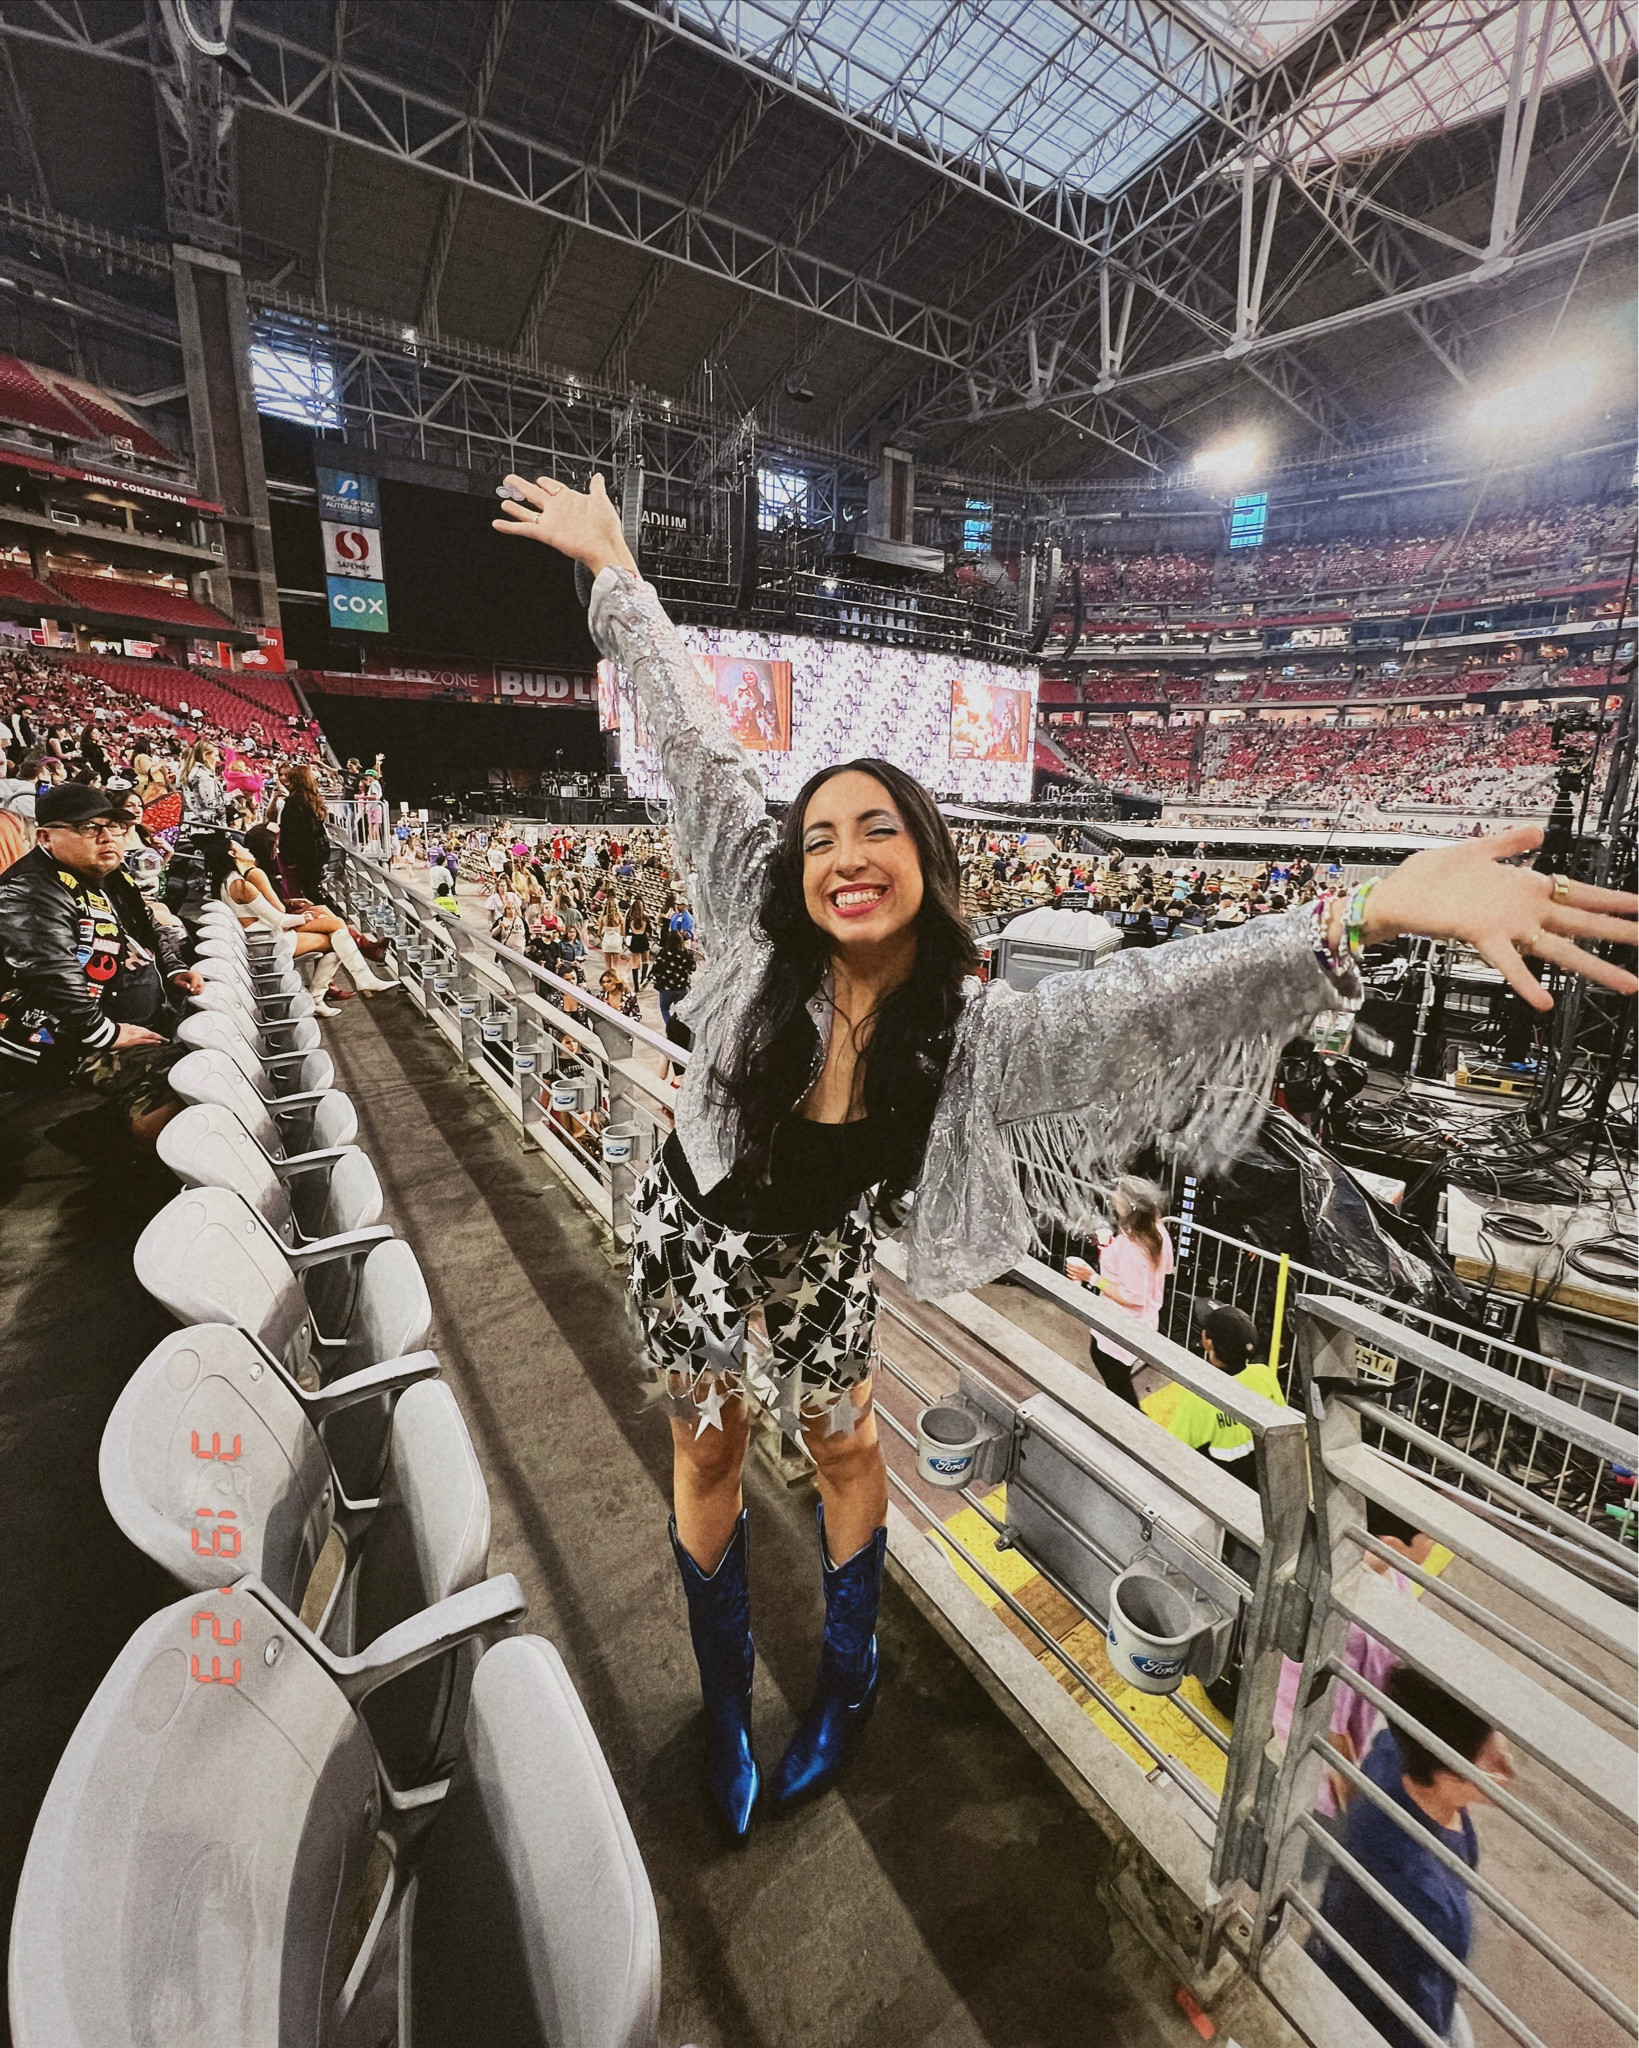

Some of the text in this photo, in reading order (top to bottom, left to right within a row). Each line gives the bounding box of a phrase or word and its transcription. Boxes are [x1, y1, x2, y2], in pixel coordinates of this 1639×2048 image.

[82, 473, 187, 505] JIMMY CONZELMAN
[322, 493, 349, 505] PACIFIC
[326, 502, 374, 515] AUTOMATION
[641, 510, 687, 529] ADIUM
[337, 561, 370, 572] SAFEWAY
[333, 594, 384, 616] COX
[935, 1457, 967, 1473] Ford
[1141, 1658, 1183, 1676] Ford
